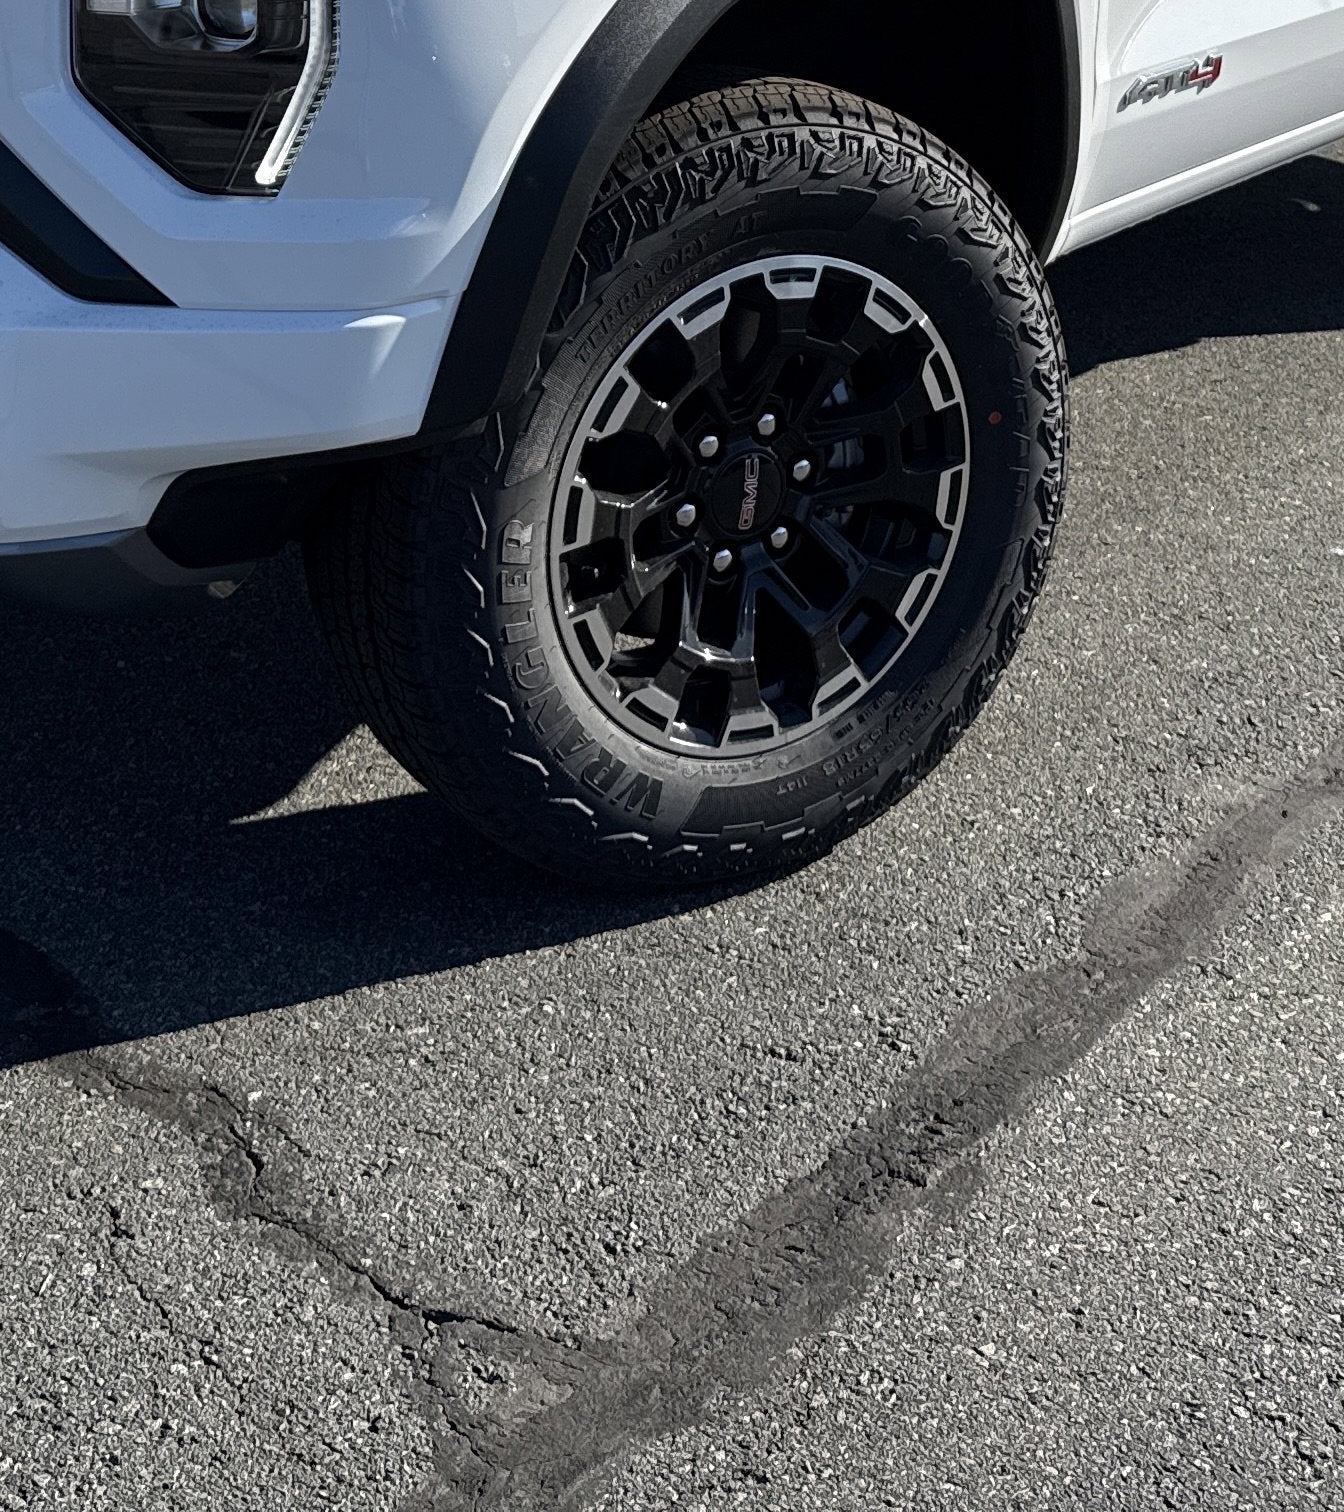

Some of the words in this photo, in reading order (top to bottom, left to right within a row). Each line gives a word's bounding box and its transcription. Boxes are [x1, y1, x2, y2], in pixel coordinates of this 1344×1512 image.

[1116, 50, 1224, 114] AT4
[737, 458, 760, 531] GMC
[501, 519, 664, 819] WRANGLER
